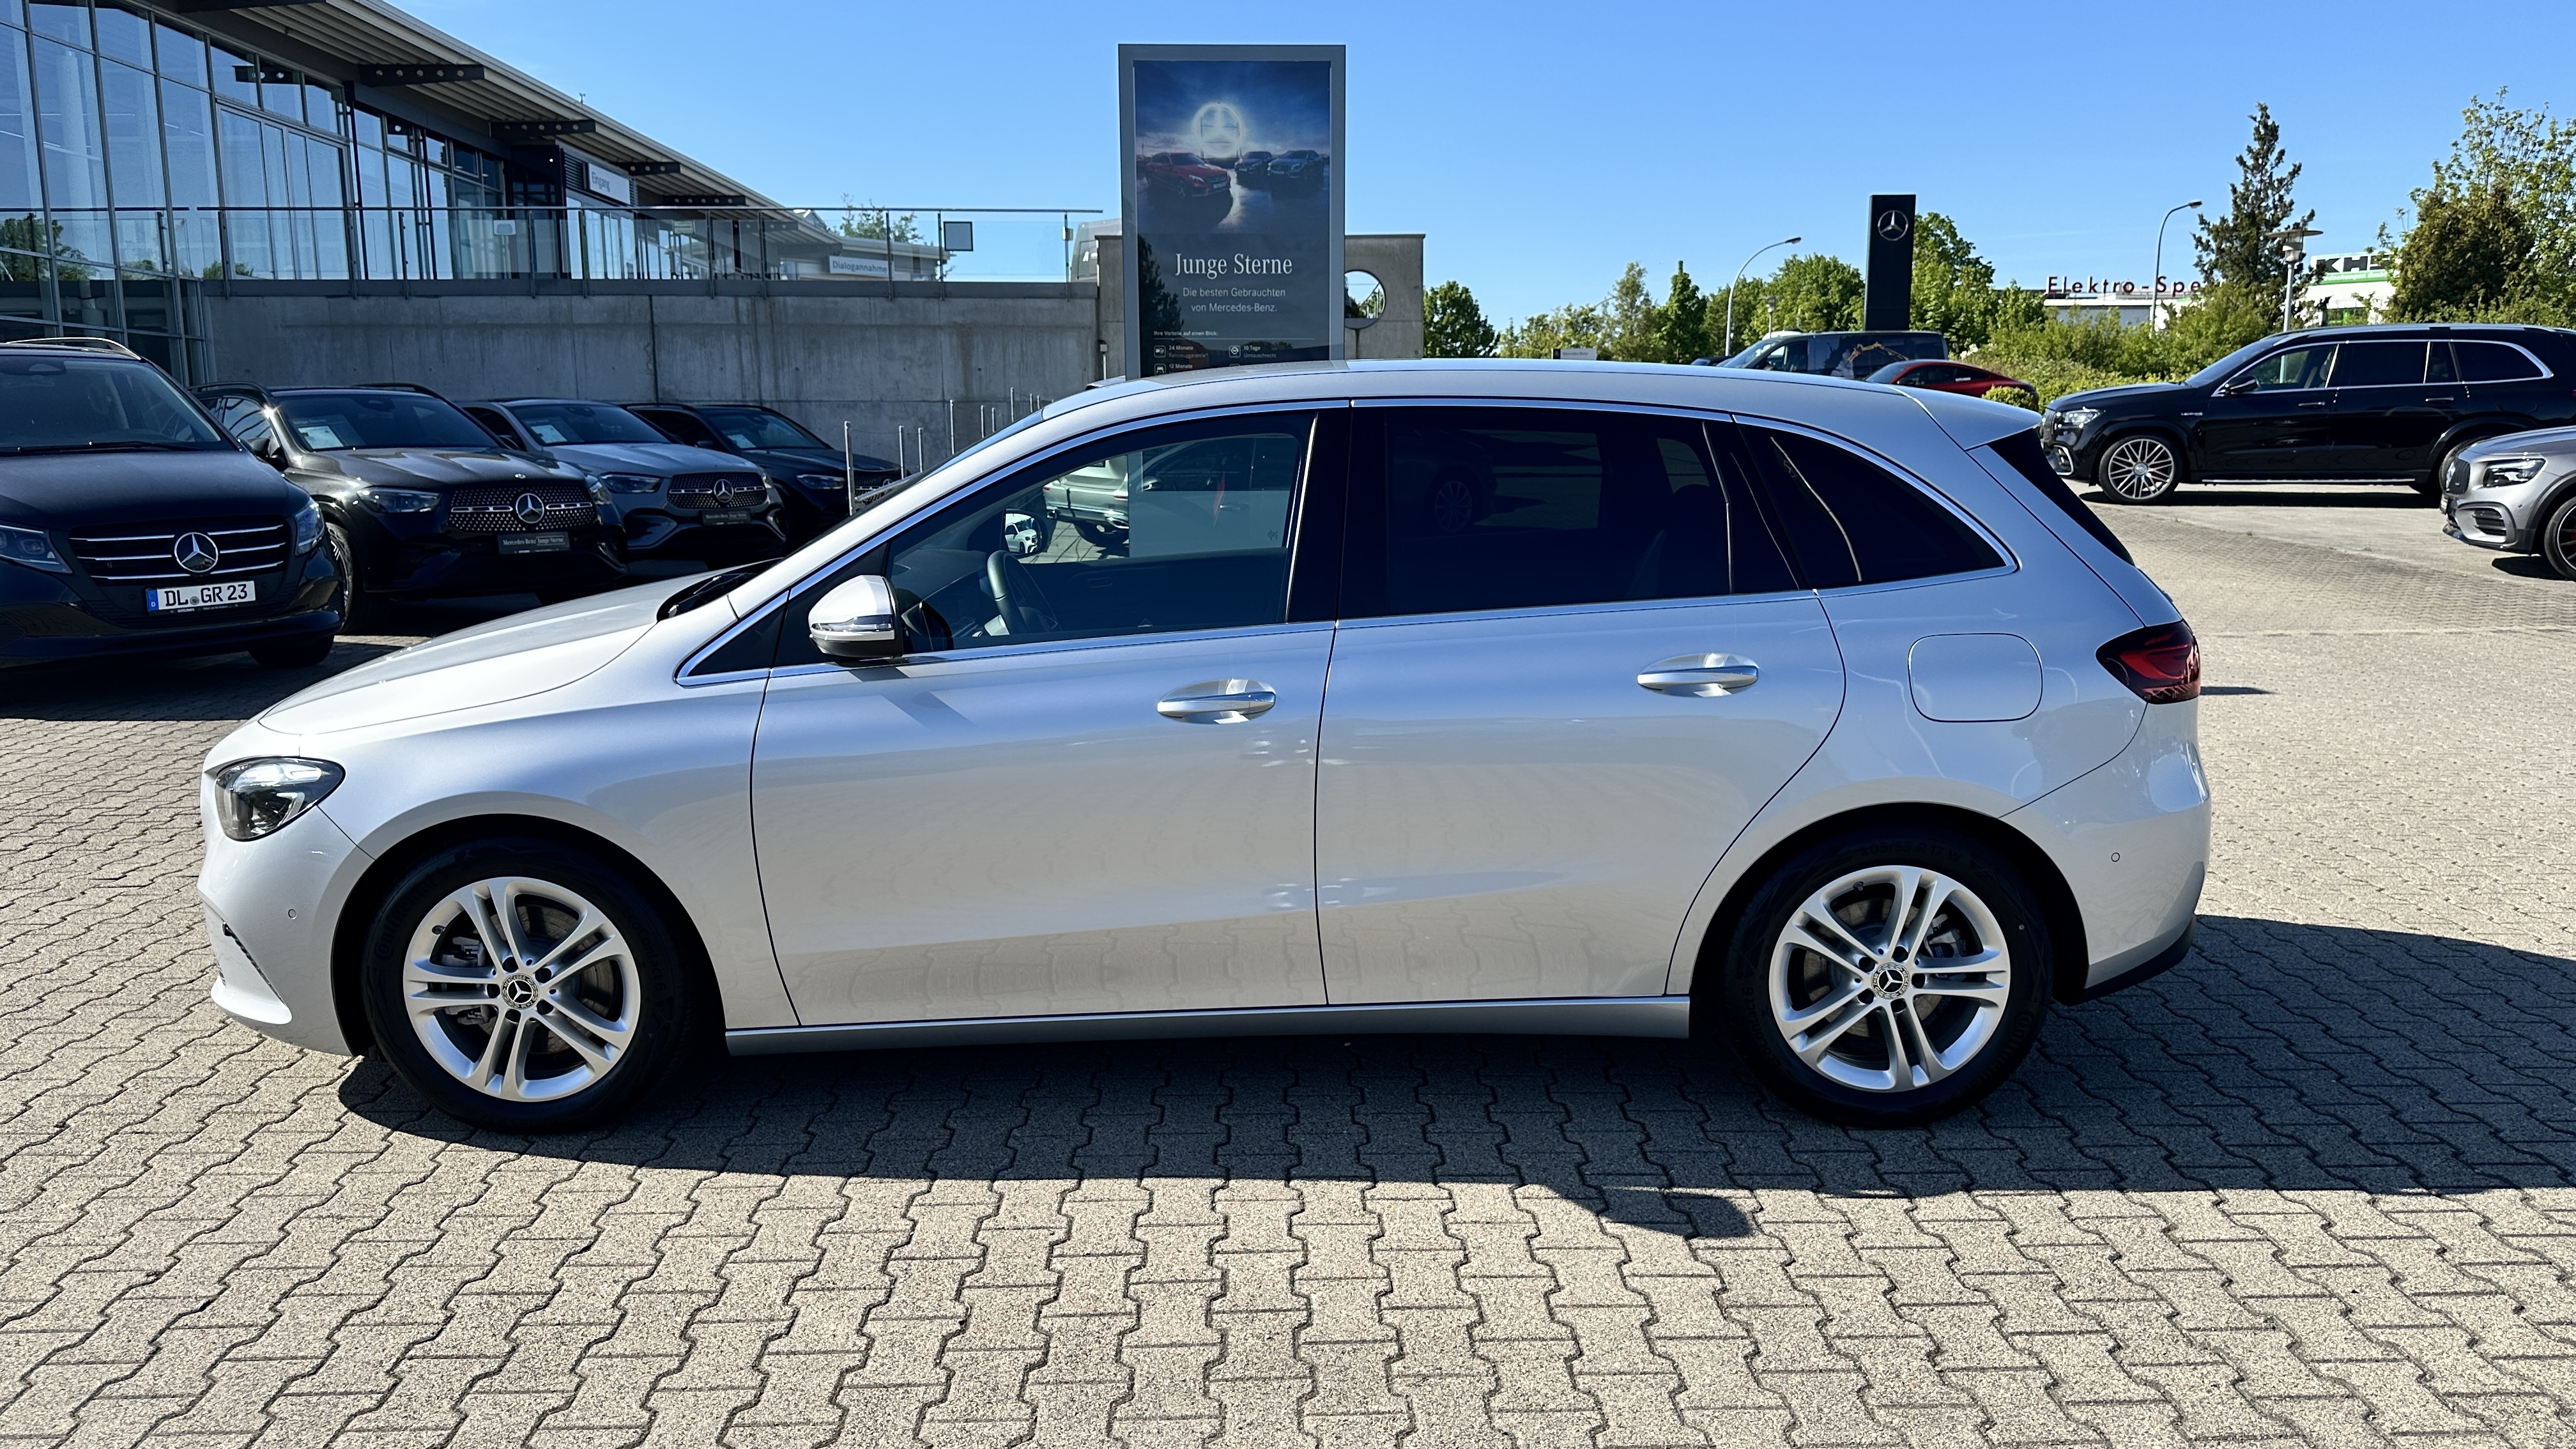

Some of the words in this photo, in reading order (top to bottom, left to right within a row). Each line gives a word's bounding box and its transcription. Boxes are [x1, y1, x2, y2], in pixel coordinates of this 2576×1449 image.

[592, 171, 610, 192] Eingang
[832, 260, 887, 273] Dialogannahme
[1175, 253, 1227, 280] Junge
[1234, 253, 1292, 275] Sterne
[1183, 288, 1197, 297] Die
[1200, 288, 1229, 297] besten
[1230, 288, 1286, 297] Gebrauchten
[1209, 303, 1277, 312] Mercedes-Benz.
[164, 590, 188, 606] DL
[201, 586, 223, 603] GR
[227, 584, 247, 601] 23
